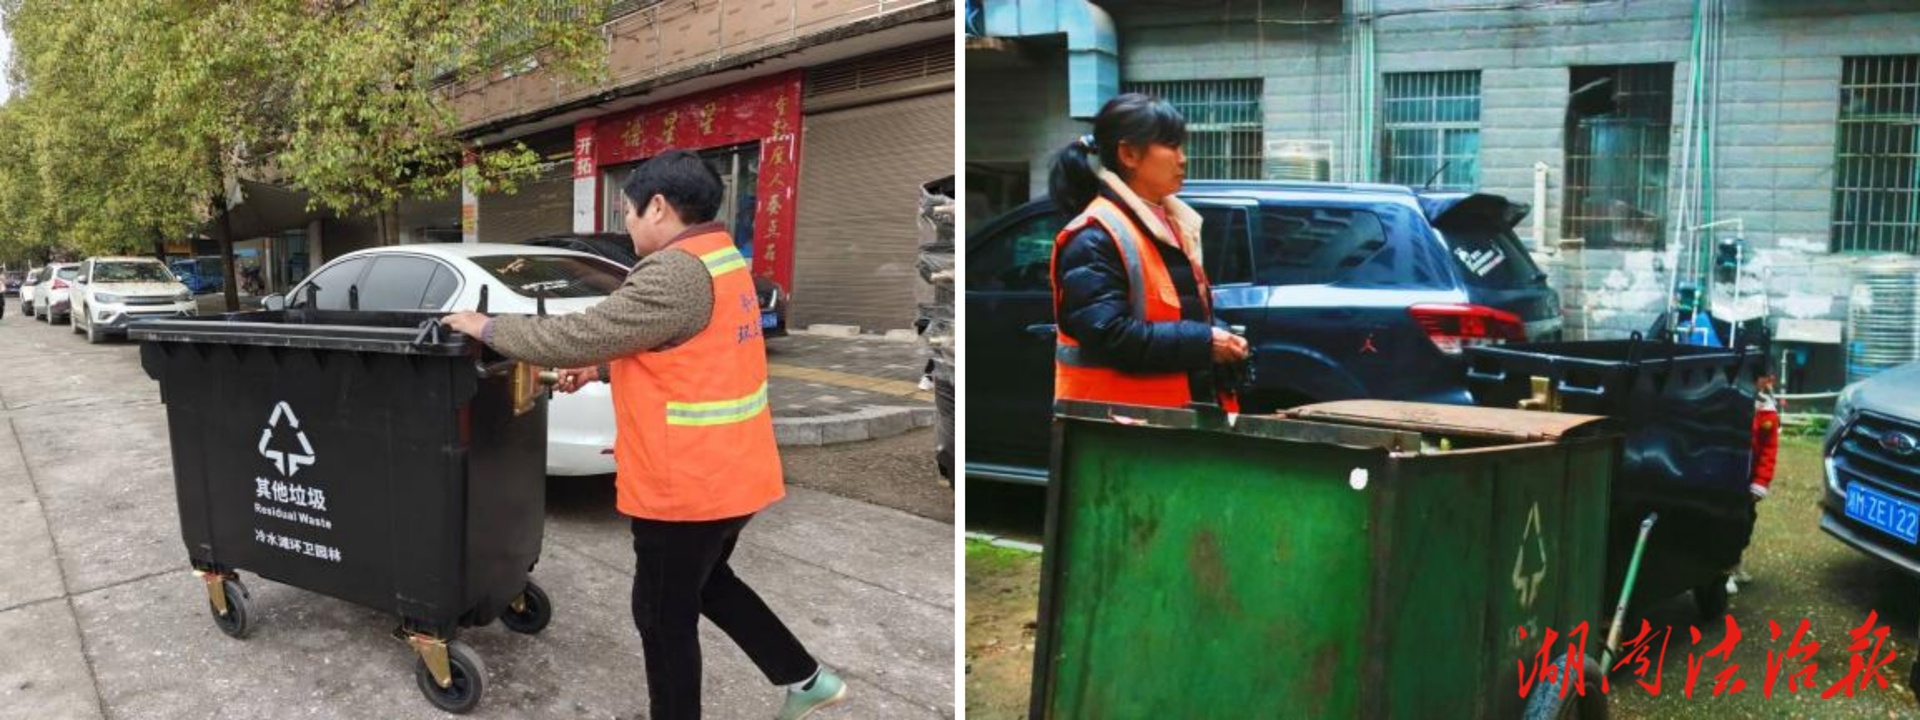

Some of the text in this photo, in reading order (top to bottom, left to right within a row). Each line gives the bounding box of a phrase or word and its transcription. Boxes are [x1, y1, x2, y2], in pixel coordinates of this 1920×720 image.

[577, 137, 592, 175] 开拓
[255, 476, 327, 511] 其他垃圾
[254, 502, 332, 529] Residual Waste
